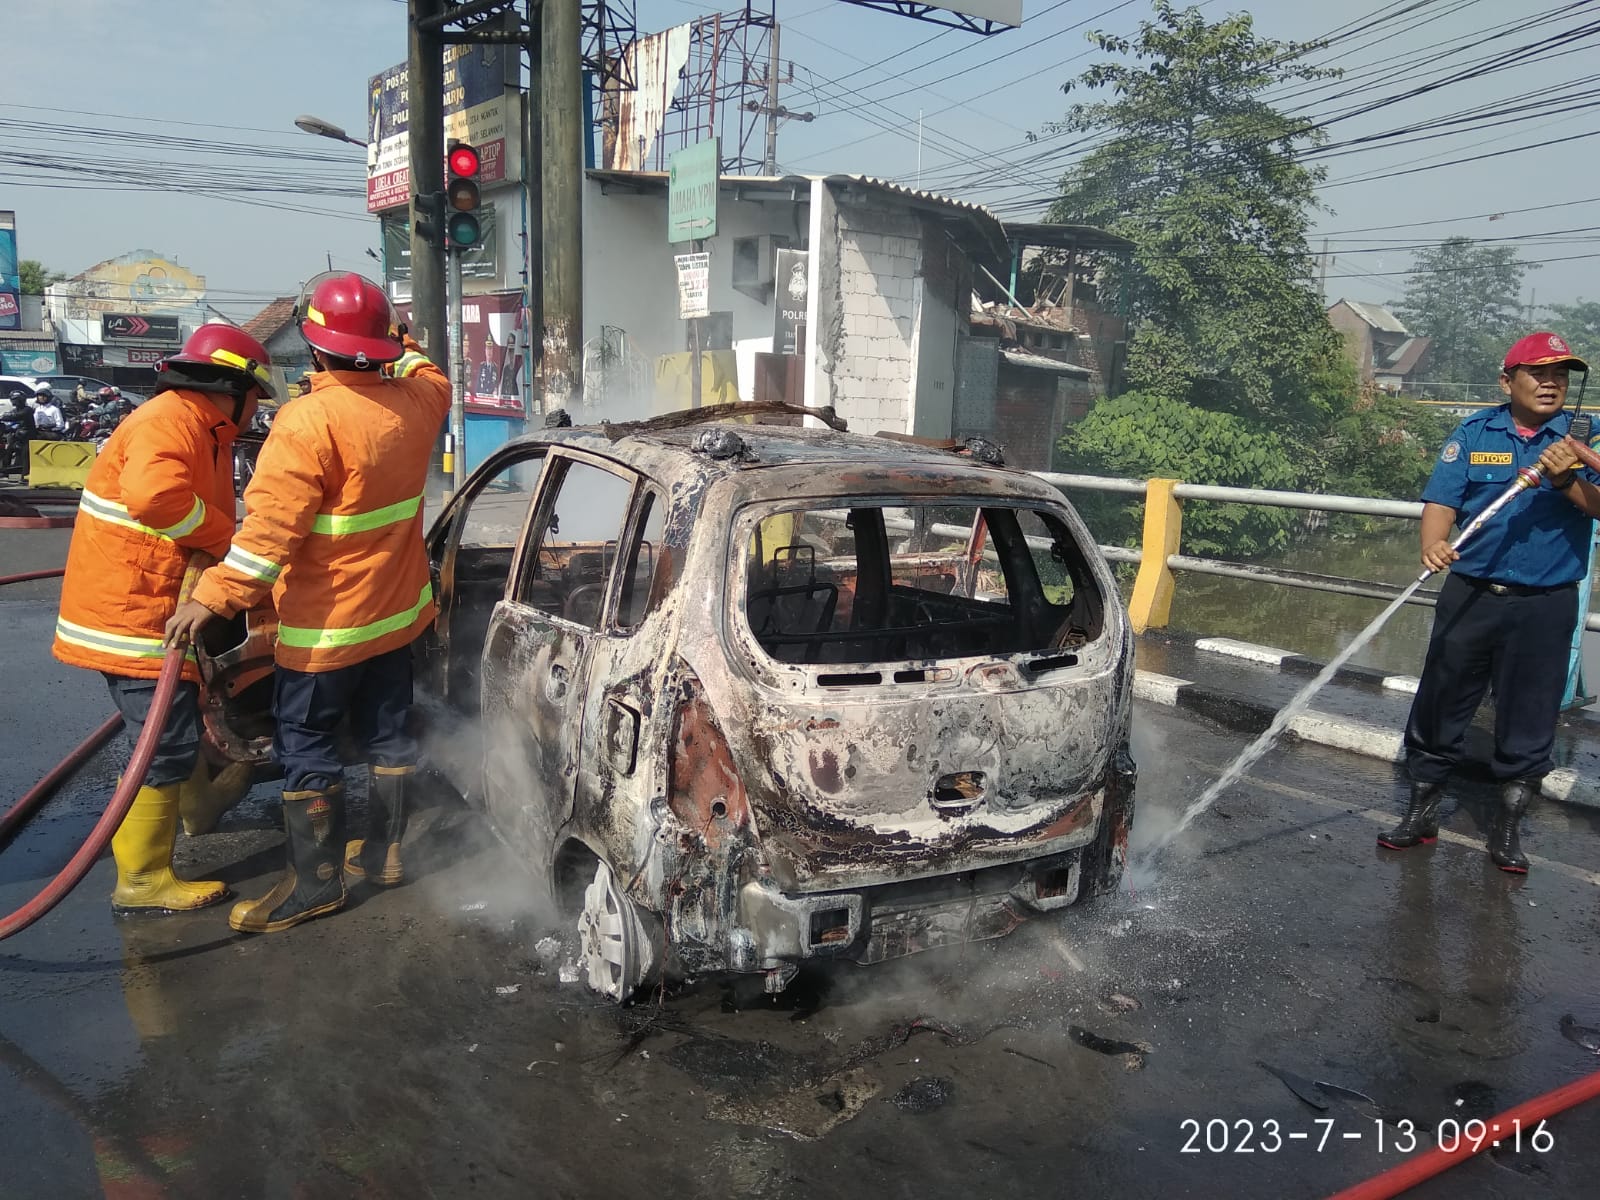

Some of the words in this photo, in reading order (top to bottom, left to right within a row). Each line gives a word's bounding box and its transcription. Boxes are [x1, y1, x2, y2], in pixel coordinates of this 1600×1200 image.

[698, 181, 715, 208] YPM
[108, 318, 124, 329] LA
[1473, 454, 1510, 463] SUTOYO
